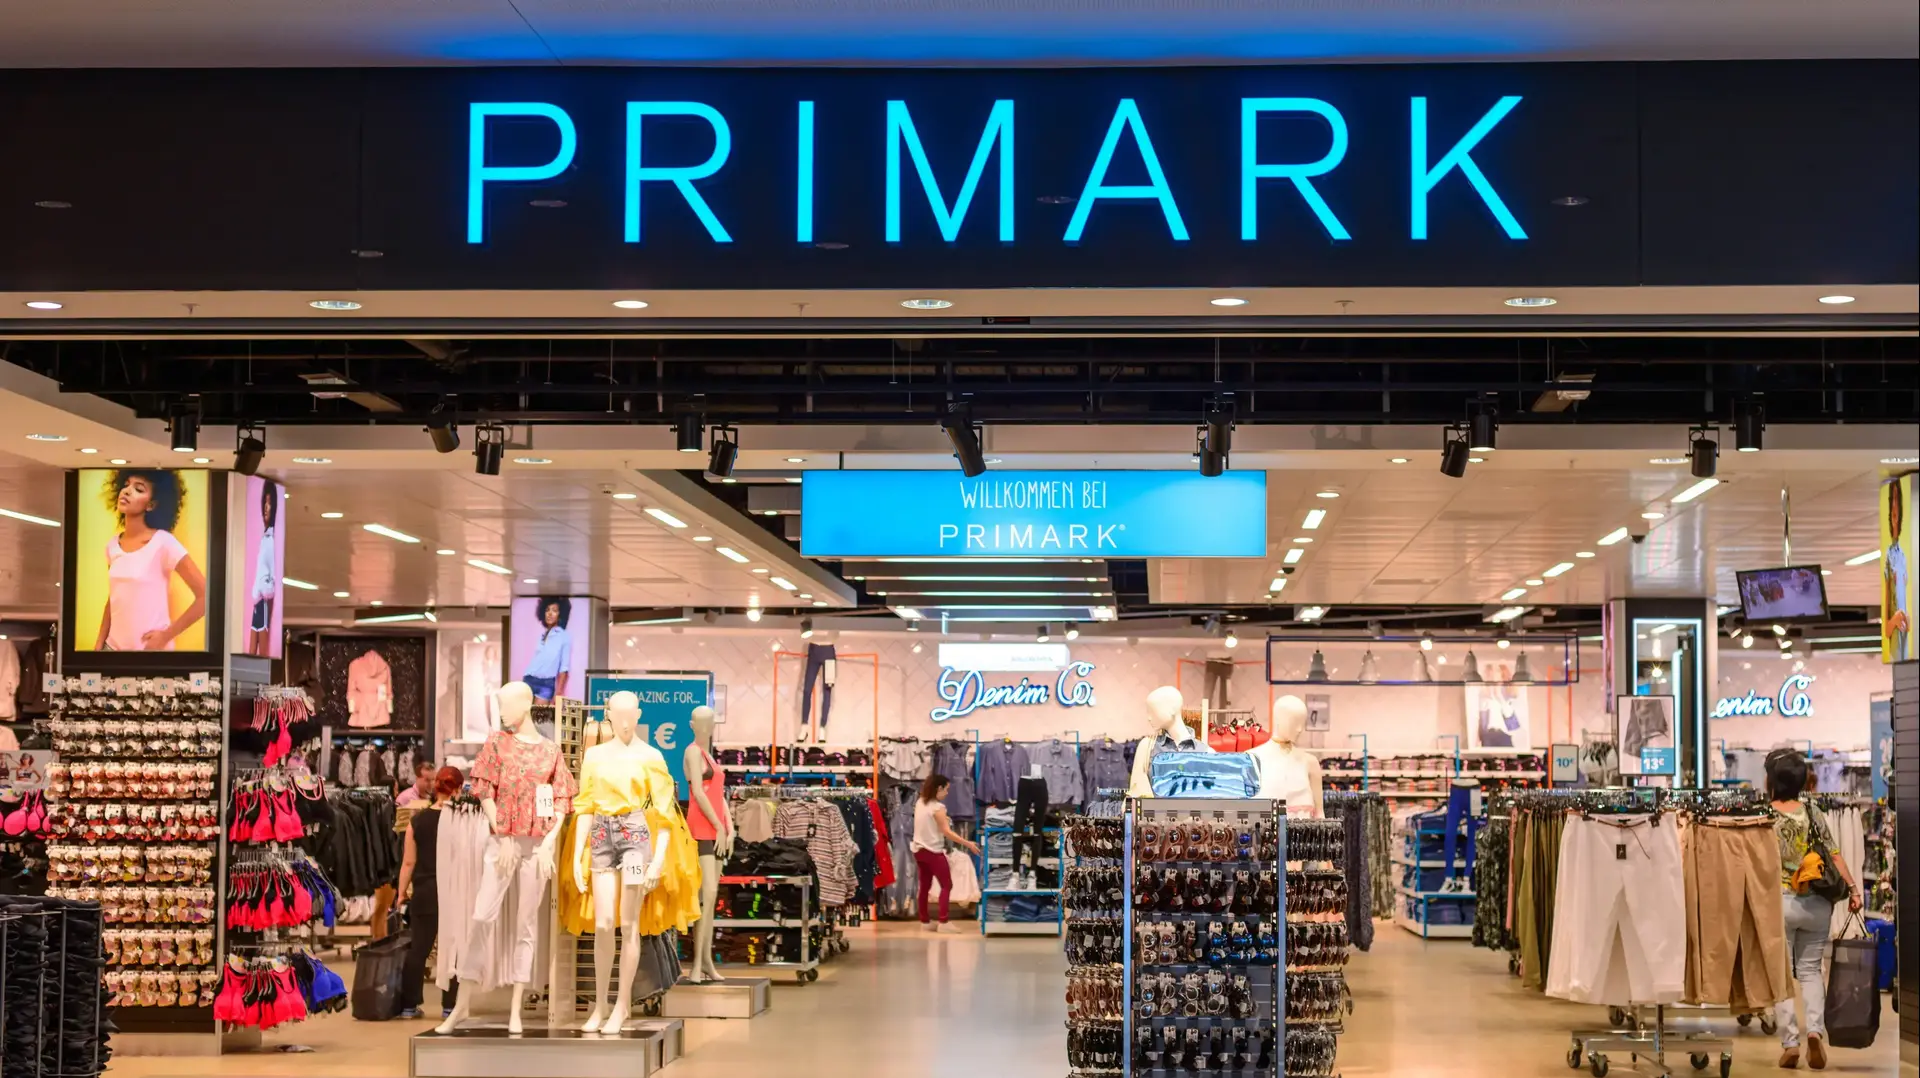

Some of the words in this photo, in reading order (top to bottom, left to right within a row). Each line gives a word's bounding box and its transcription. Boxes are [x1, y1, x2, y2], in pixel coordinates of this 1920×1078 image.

[467, 94, 1529, 245] PRIMARK
[960, 480, 1074, 509] WILLKOMMEN
[1082, 480, 1107, 509] BEI
[930, 665, 1050, 722] Denim
[1709, 689, 1774, 718] enim
